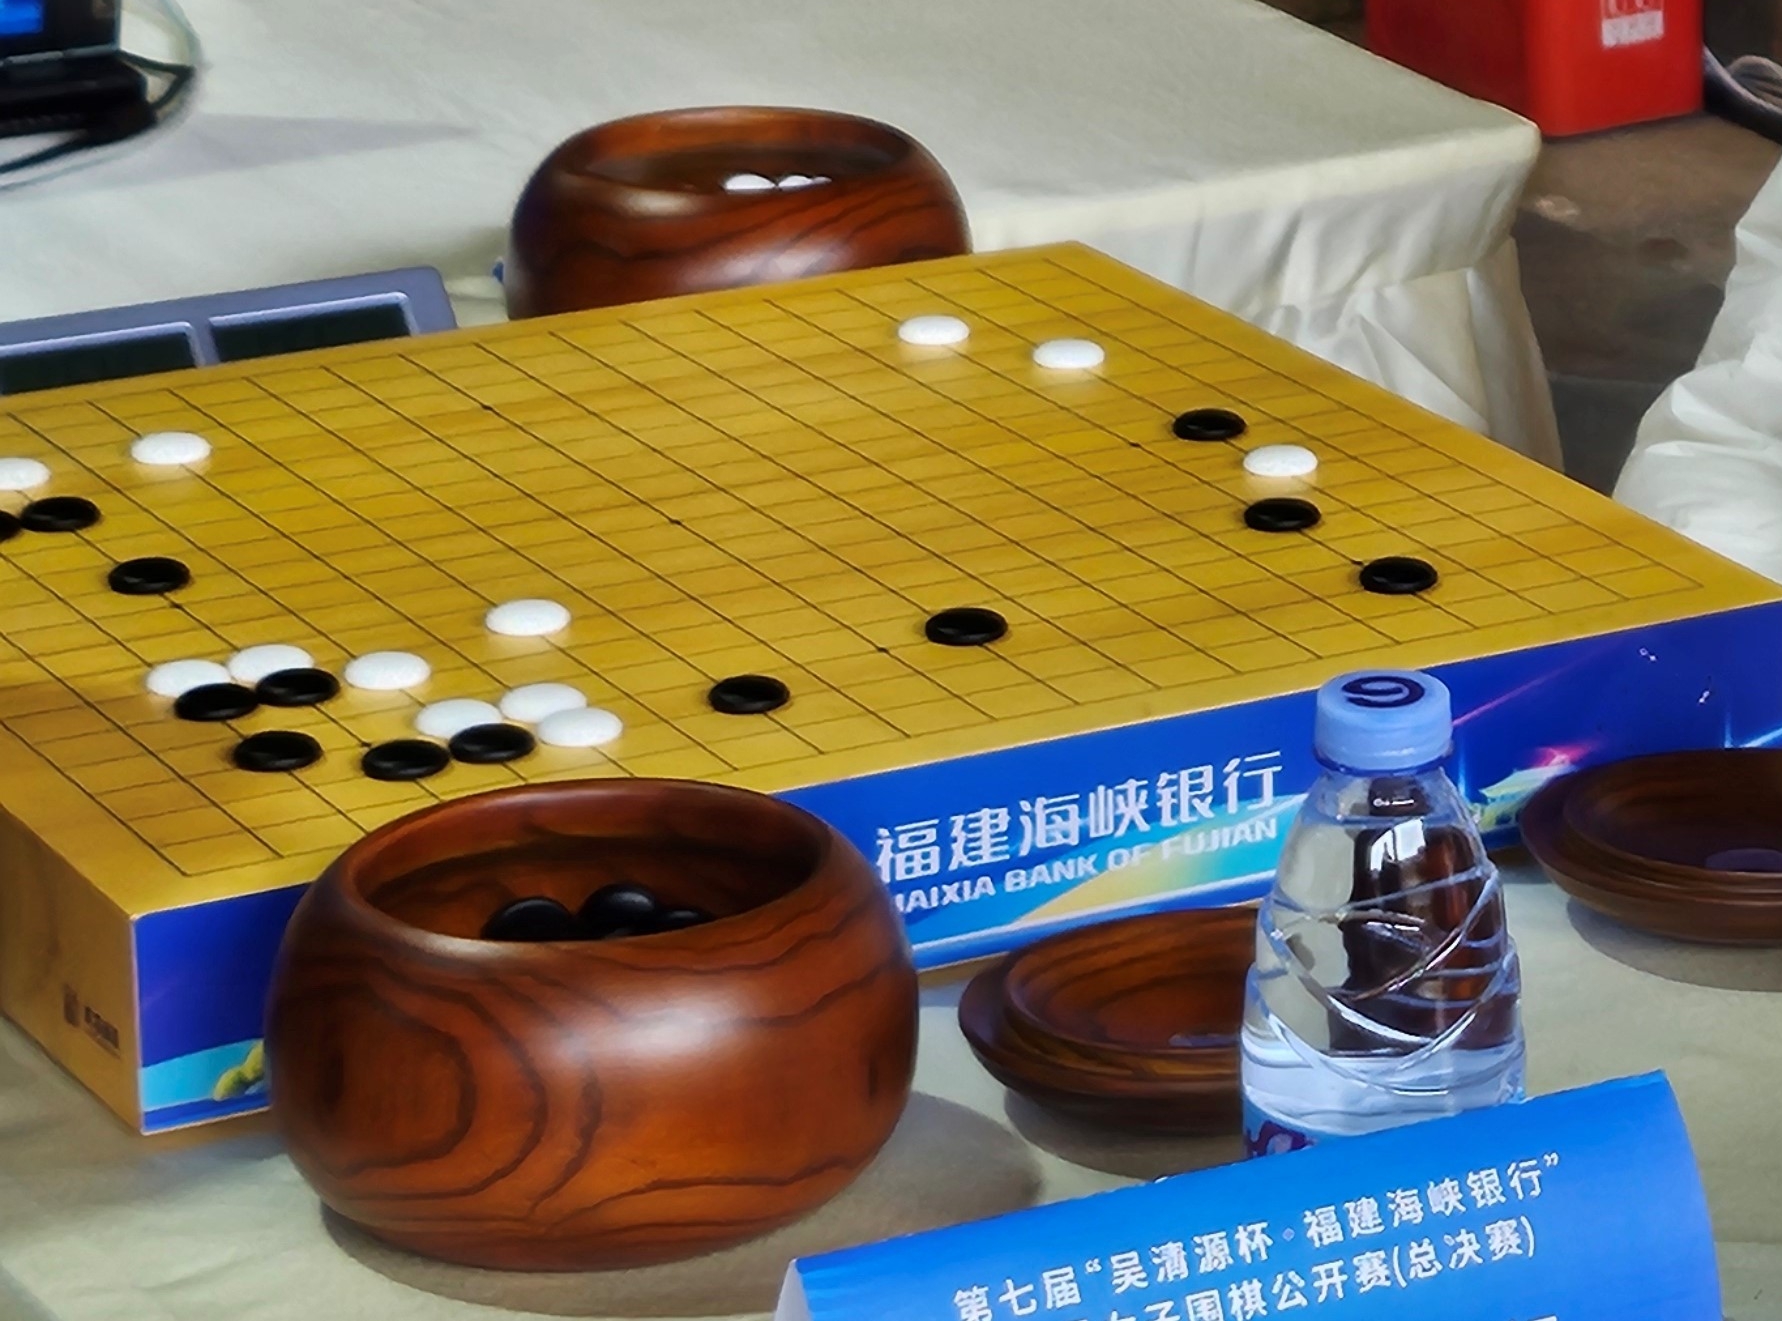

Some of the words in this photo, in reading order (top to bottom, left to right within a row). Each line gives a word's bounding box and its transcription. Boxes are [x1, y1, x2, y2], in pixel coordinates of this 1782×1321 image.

[876, 751, 1283, 884] 福建海峡银行
[1004, 853, 1098, 893] BANK
[1106, 842, 1150, 872] OF
[1161, 818, 1278, 860] FUJIAN
